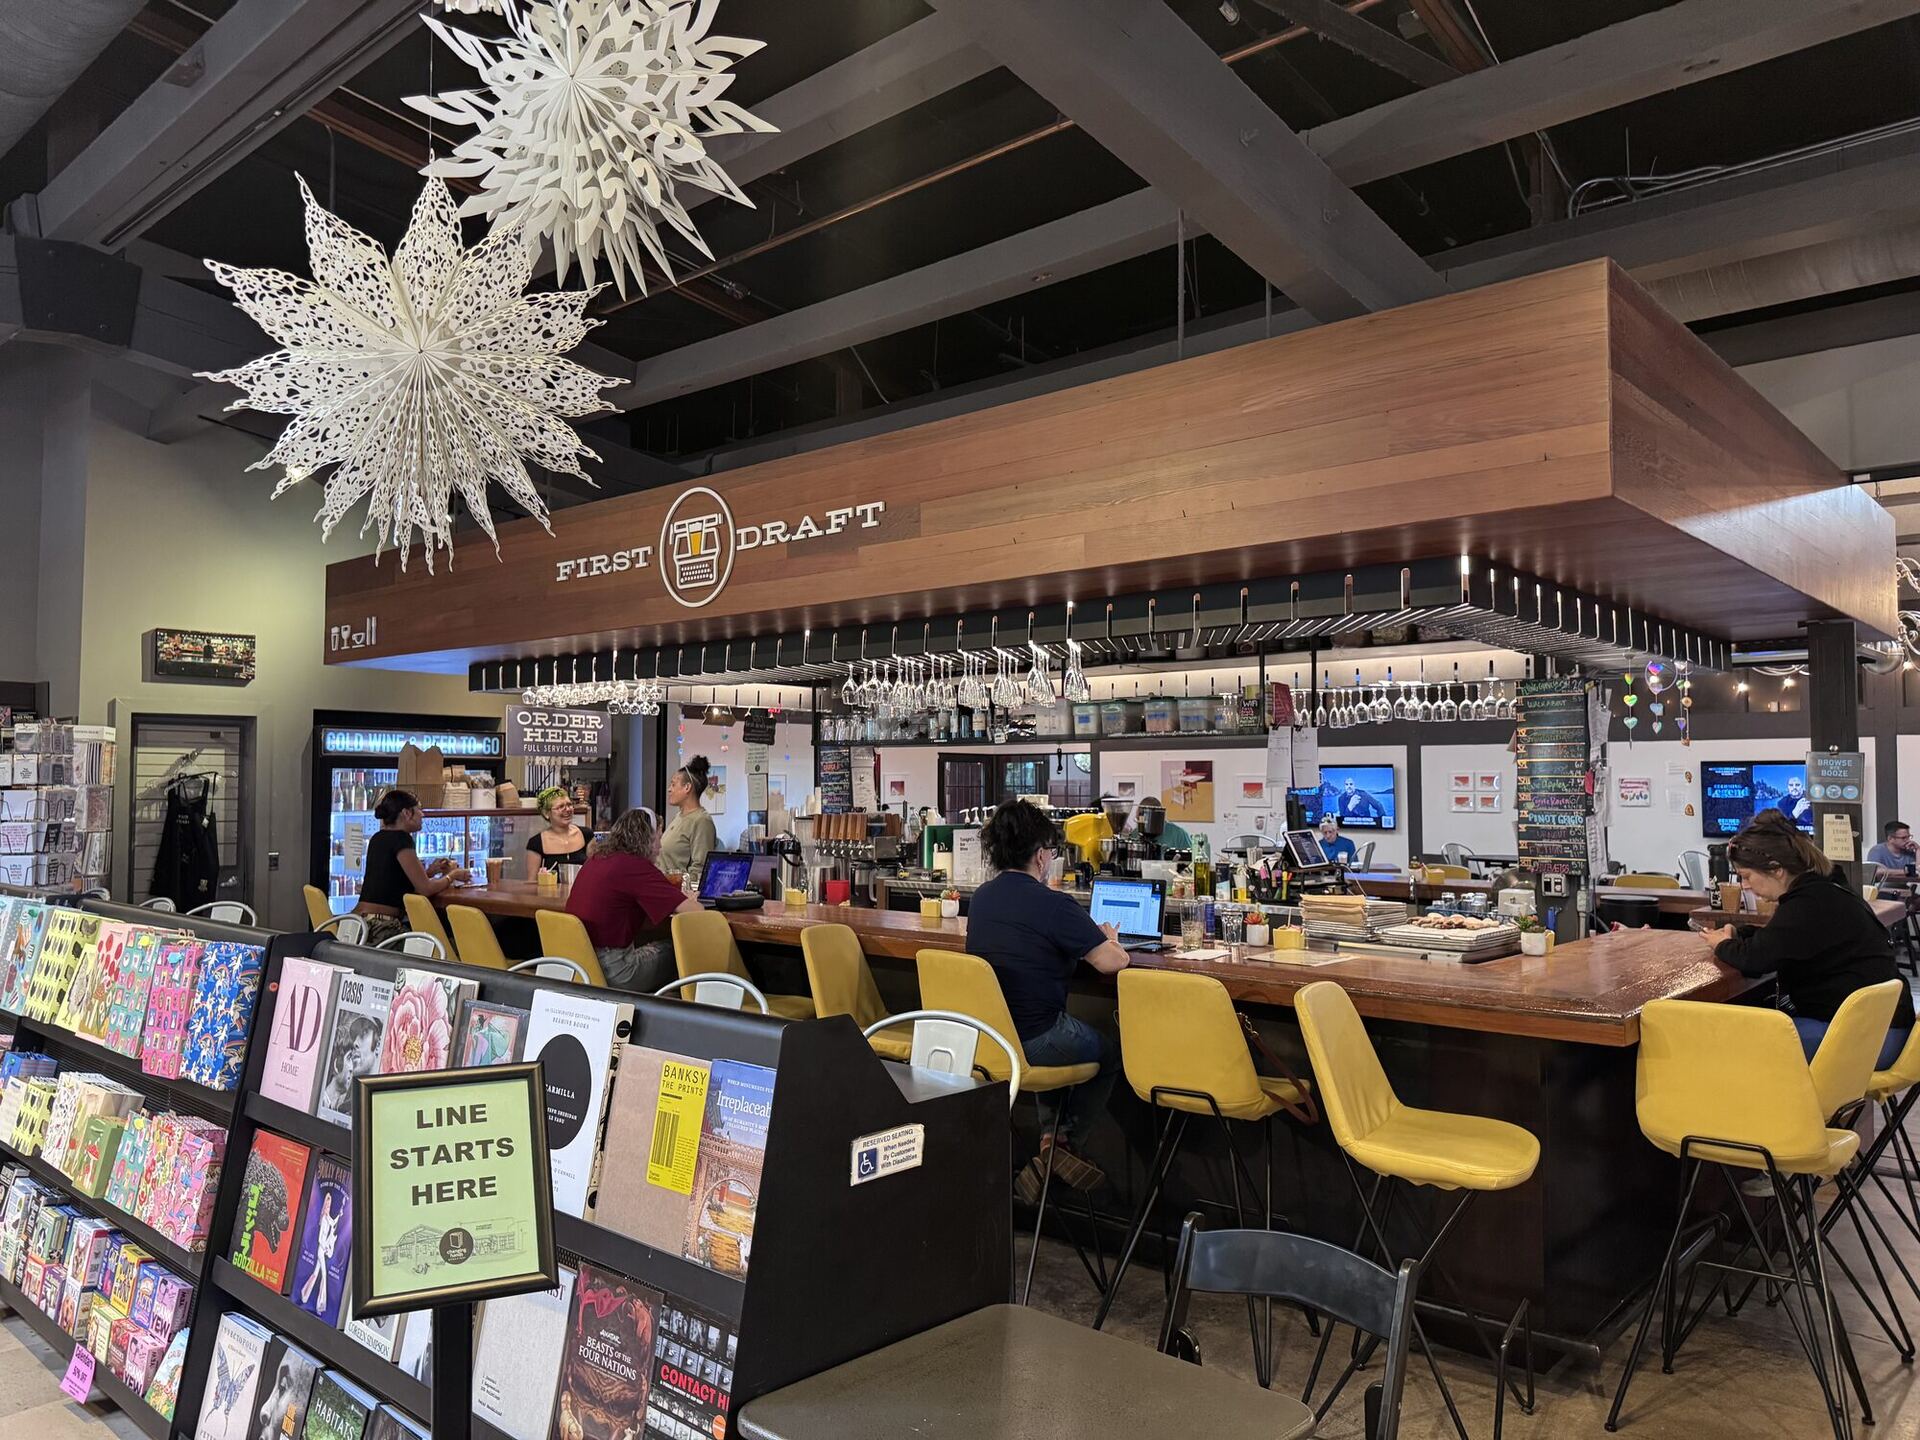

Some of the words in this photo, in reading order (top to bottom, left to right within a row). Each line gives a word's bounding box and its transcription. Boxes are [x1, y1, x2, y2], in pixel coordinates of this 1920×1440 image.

[556, 546, 653, 582] FIRST
[736, 501, 886, 551] DRAFT
[517, 711, 603, 730] ORDER
[326, 732, 363, 752] COLD
[368, 733, 405, 752] WINE
[460, 736, 500, 755] TO-GO
[523, 728, 598, 744] HERE
[523, 744, 540, 752] FULL
[544, 745, 572, 753] SERVICE
[1528, 813, 1556, 824] PINOT
[272, 983, 322, 1054] AD
[281, 1061, 299, 1076] HOME
[664, 1064, 708, 1086] BANKSY
[662, 1080, 674, 1090] THE
[678, 1083, 704, 1097] PRINTS
[416, 1103, 487, 1130] LINE
[863, 1136, 891, 1148] RESERVED
[891, 1129, 914, 1139] SEATING
[883, 1143, 897, 1152] When
[898, 1138, 916, 1147] Needed
[390, 1137, 514, 1170] STARTS
[890, 1147, 915, 1158] Customers
[892, 1154, 917, 1166] Disabilities
[411, 1175, 498, 1206] HERE
[232, 1251, 265, 1280] GODZILLA
[366, 1334, 390, 1357] SIMPSON
[586, 1336, 615, 1357] BEASTS
[614, 1351, 622, 1359] OF
[621, 1354, 632, 1363] THE
[578, 1345, 600, 1364] FOUR
[601, 1355, 637, 1381] NATIONS
[661, 1364, 716, 1405] CONTACT
[315, 1397, 355, 1440] HABITATS
